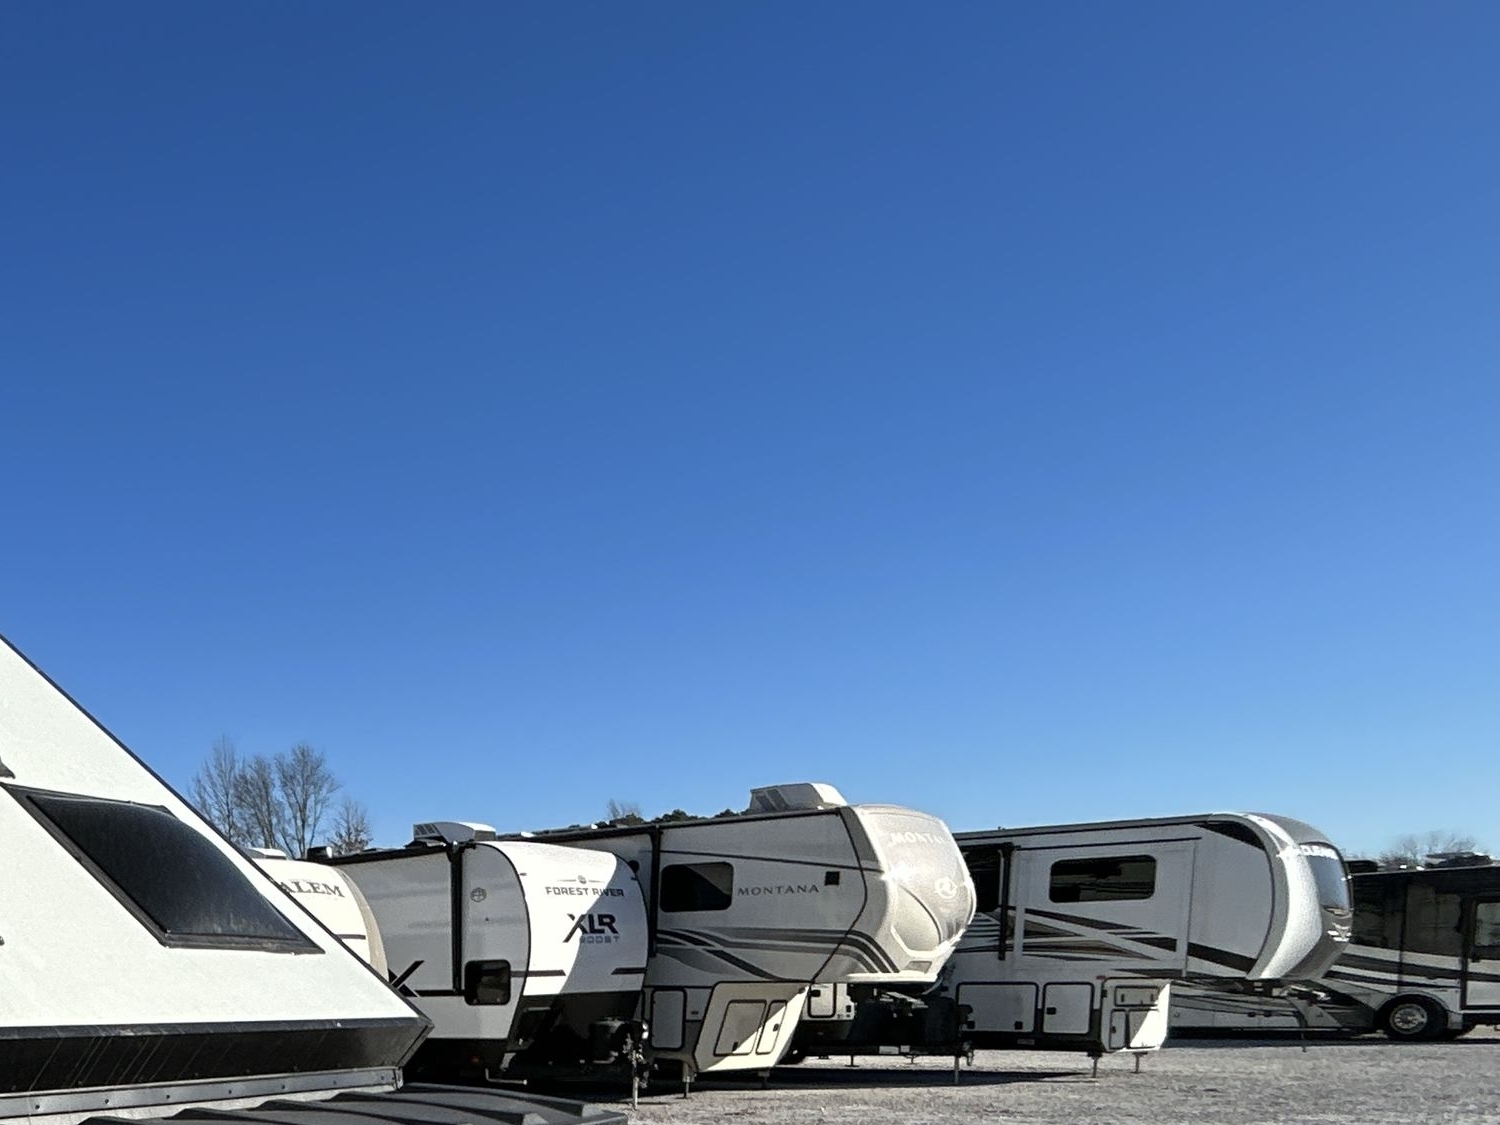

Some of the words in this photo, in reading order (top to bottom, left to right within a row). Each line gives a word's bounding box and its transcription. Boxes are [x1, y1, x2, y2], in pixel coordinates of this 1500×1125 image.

[280, 880, 345, 898] ALEM
[545, 886, 589, 896] FOREST
[592, 888, 624, 897] RIVER
[738, 884, 819, 896] MONTANA
[562, 913, 619, 943] XLR
